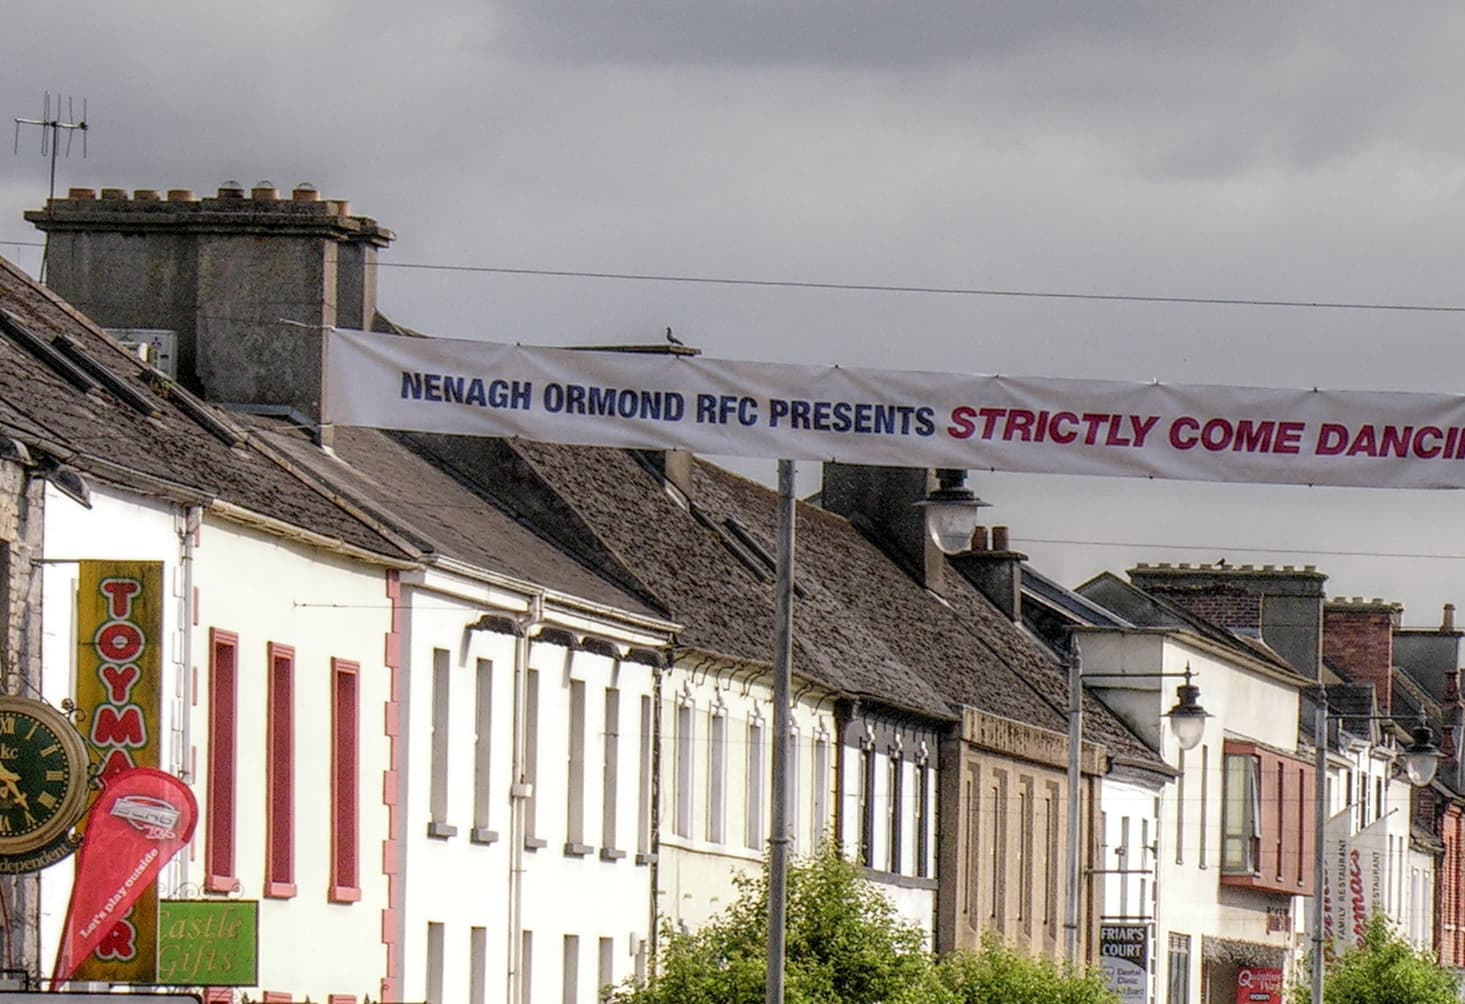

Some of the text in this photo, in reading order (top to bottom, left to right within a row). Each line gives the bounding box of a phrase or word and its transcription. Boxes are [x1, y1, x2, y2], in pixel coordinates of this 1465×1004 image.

[401, 371, 532, 411] NENAGH
[543, 383, 684, 422] ORMOND
[696, 394, 758, 426] RFC
[769, 401, 935, 436] PRESENTS
[946, 406, 1159, 448] STRICTLY
[1169, 416, 1305, 455] COME
[125, 848, 159, 887] outside
[1101, 927, 1145, 940] FRIAR'S
[1102, 943, 1142, 957] COURT
